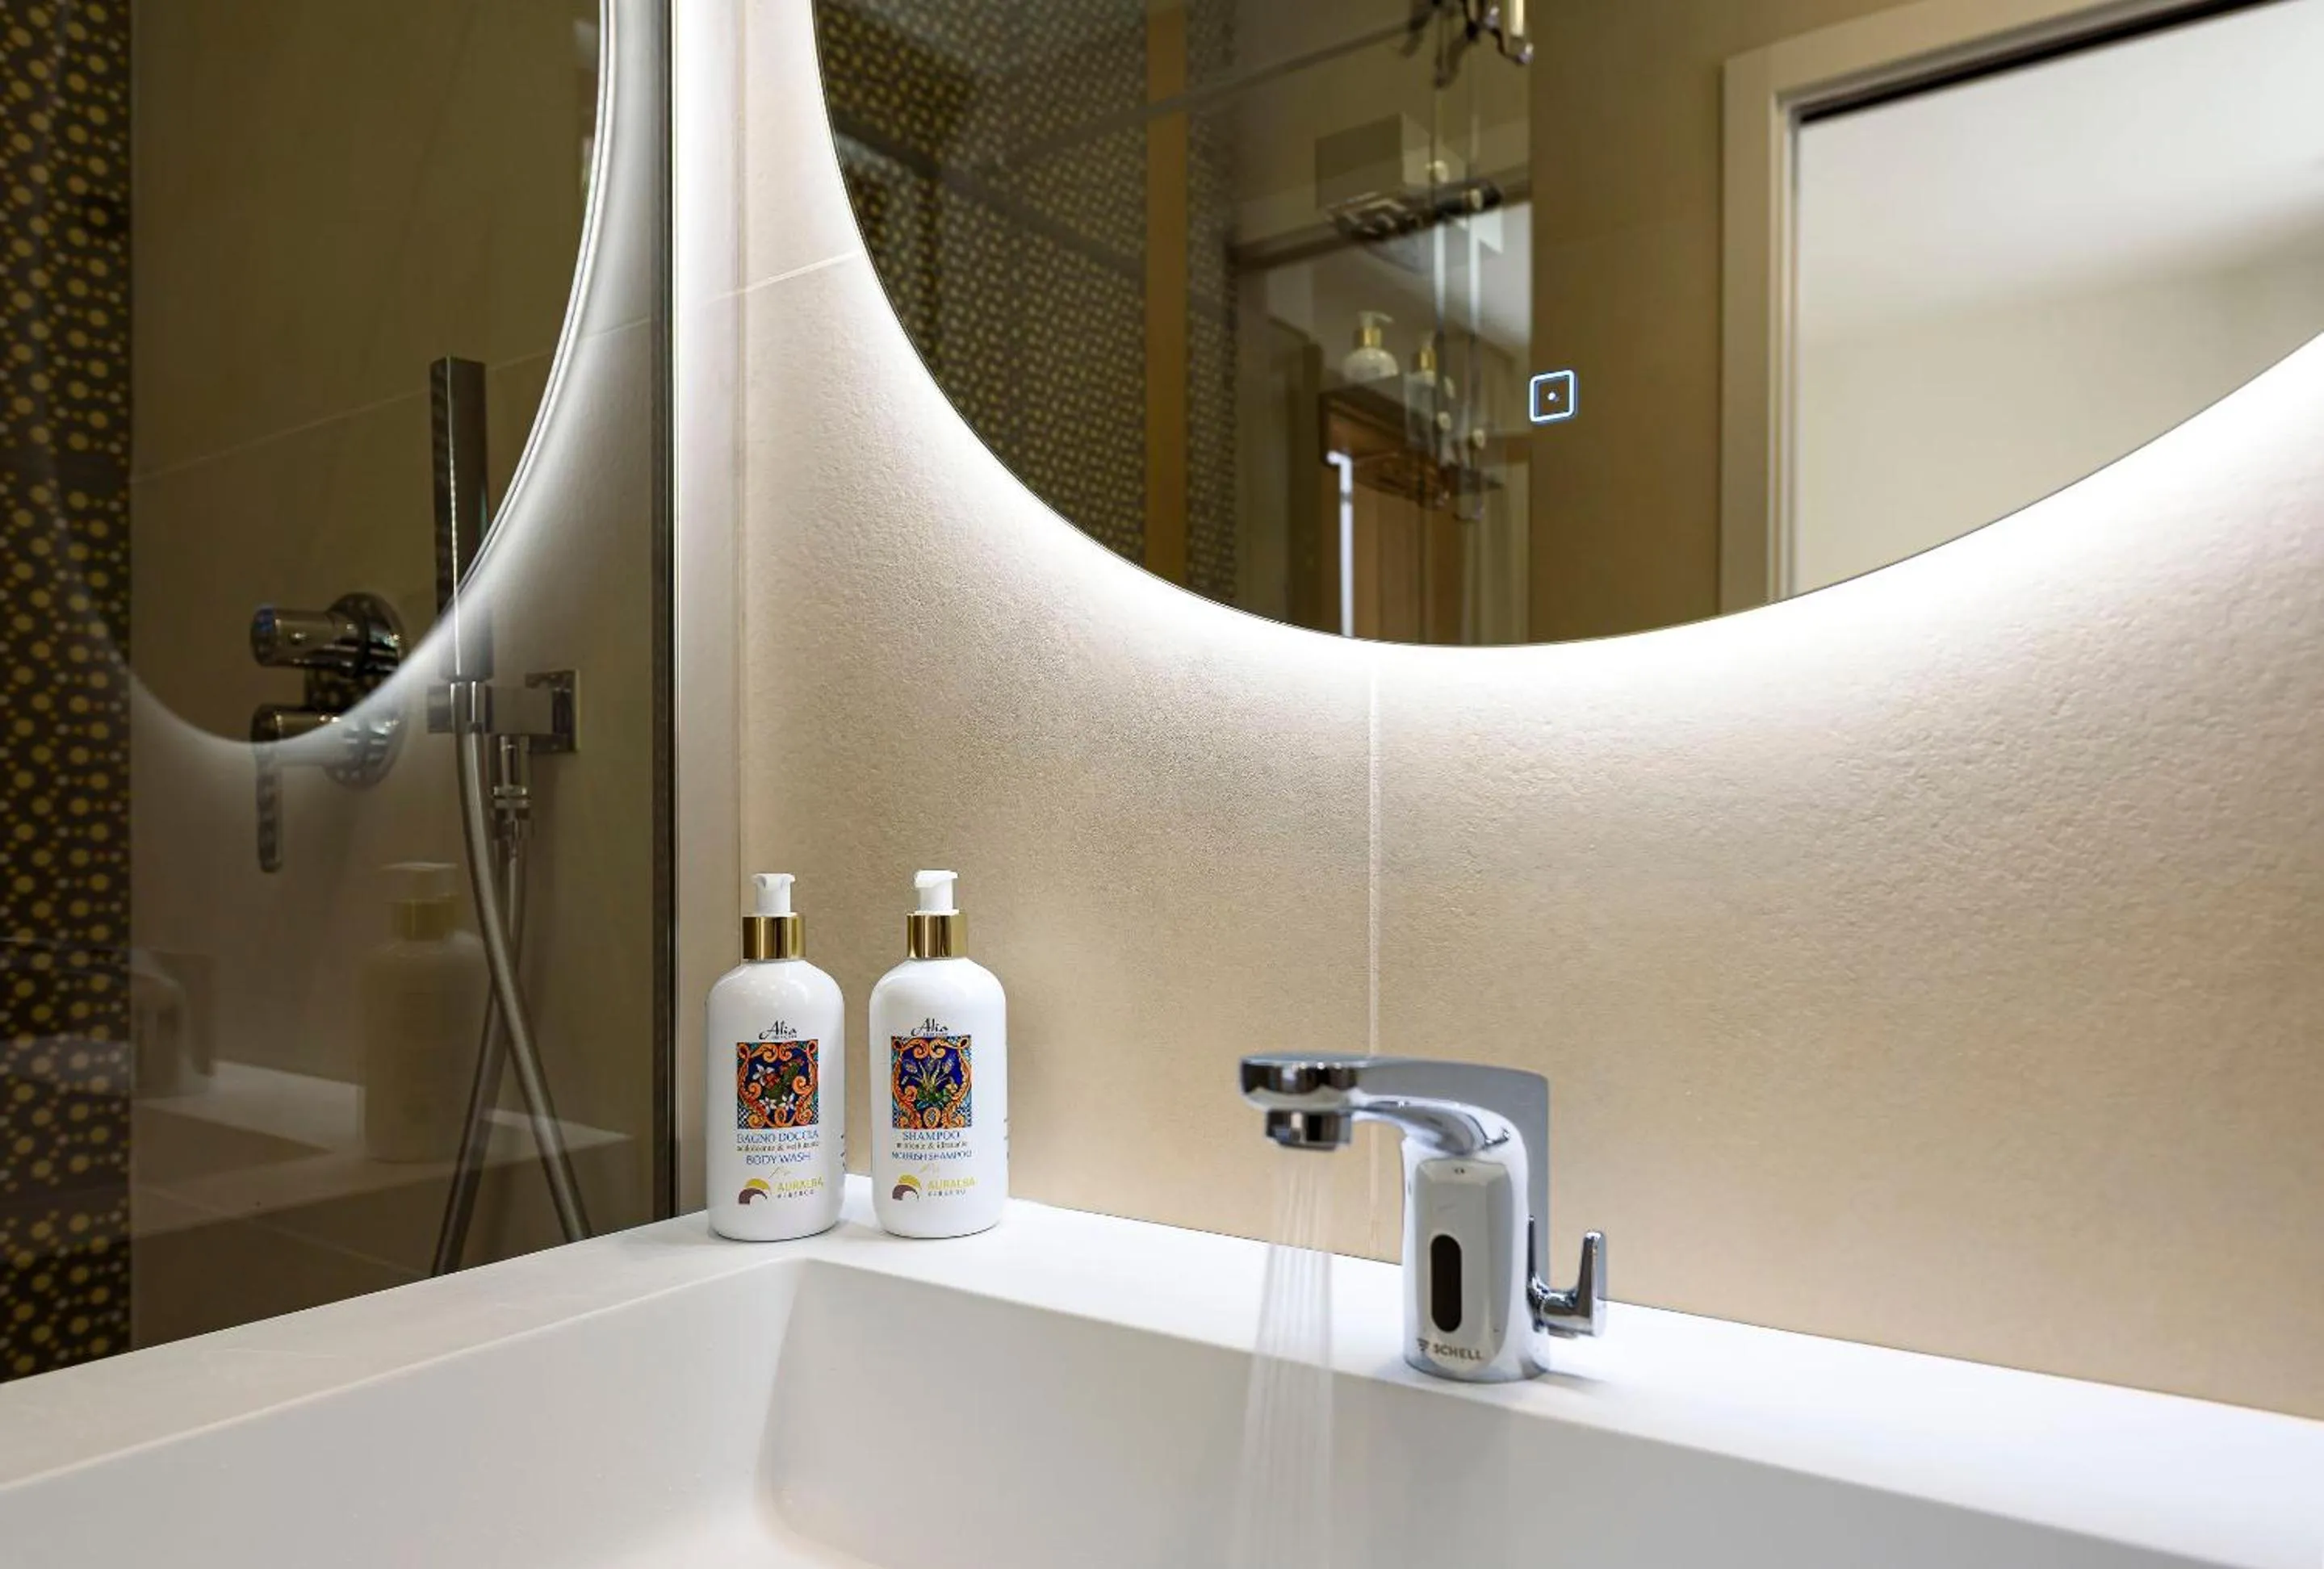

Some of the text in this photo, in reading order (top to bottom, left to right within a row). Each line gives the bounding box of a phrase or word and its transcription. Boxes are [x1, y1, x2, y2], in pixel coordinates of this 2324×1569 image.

[759, 1019, 798, 1040] Alia
[911, 1017, 949, 1037] Alia
[736, 1129, 819, 1144] BAGNO DOCCIA
[902, 1131, 961, 1141] SHAMPOO
[746, 1151, 811, 1165] BODY WASH
[1433, 1342, 1482, 1361] SCHELL
